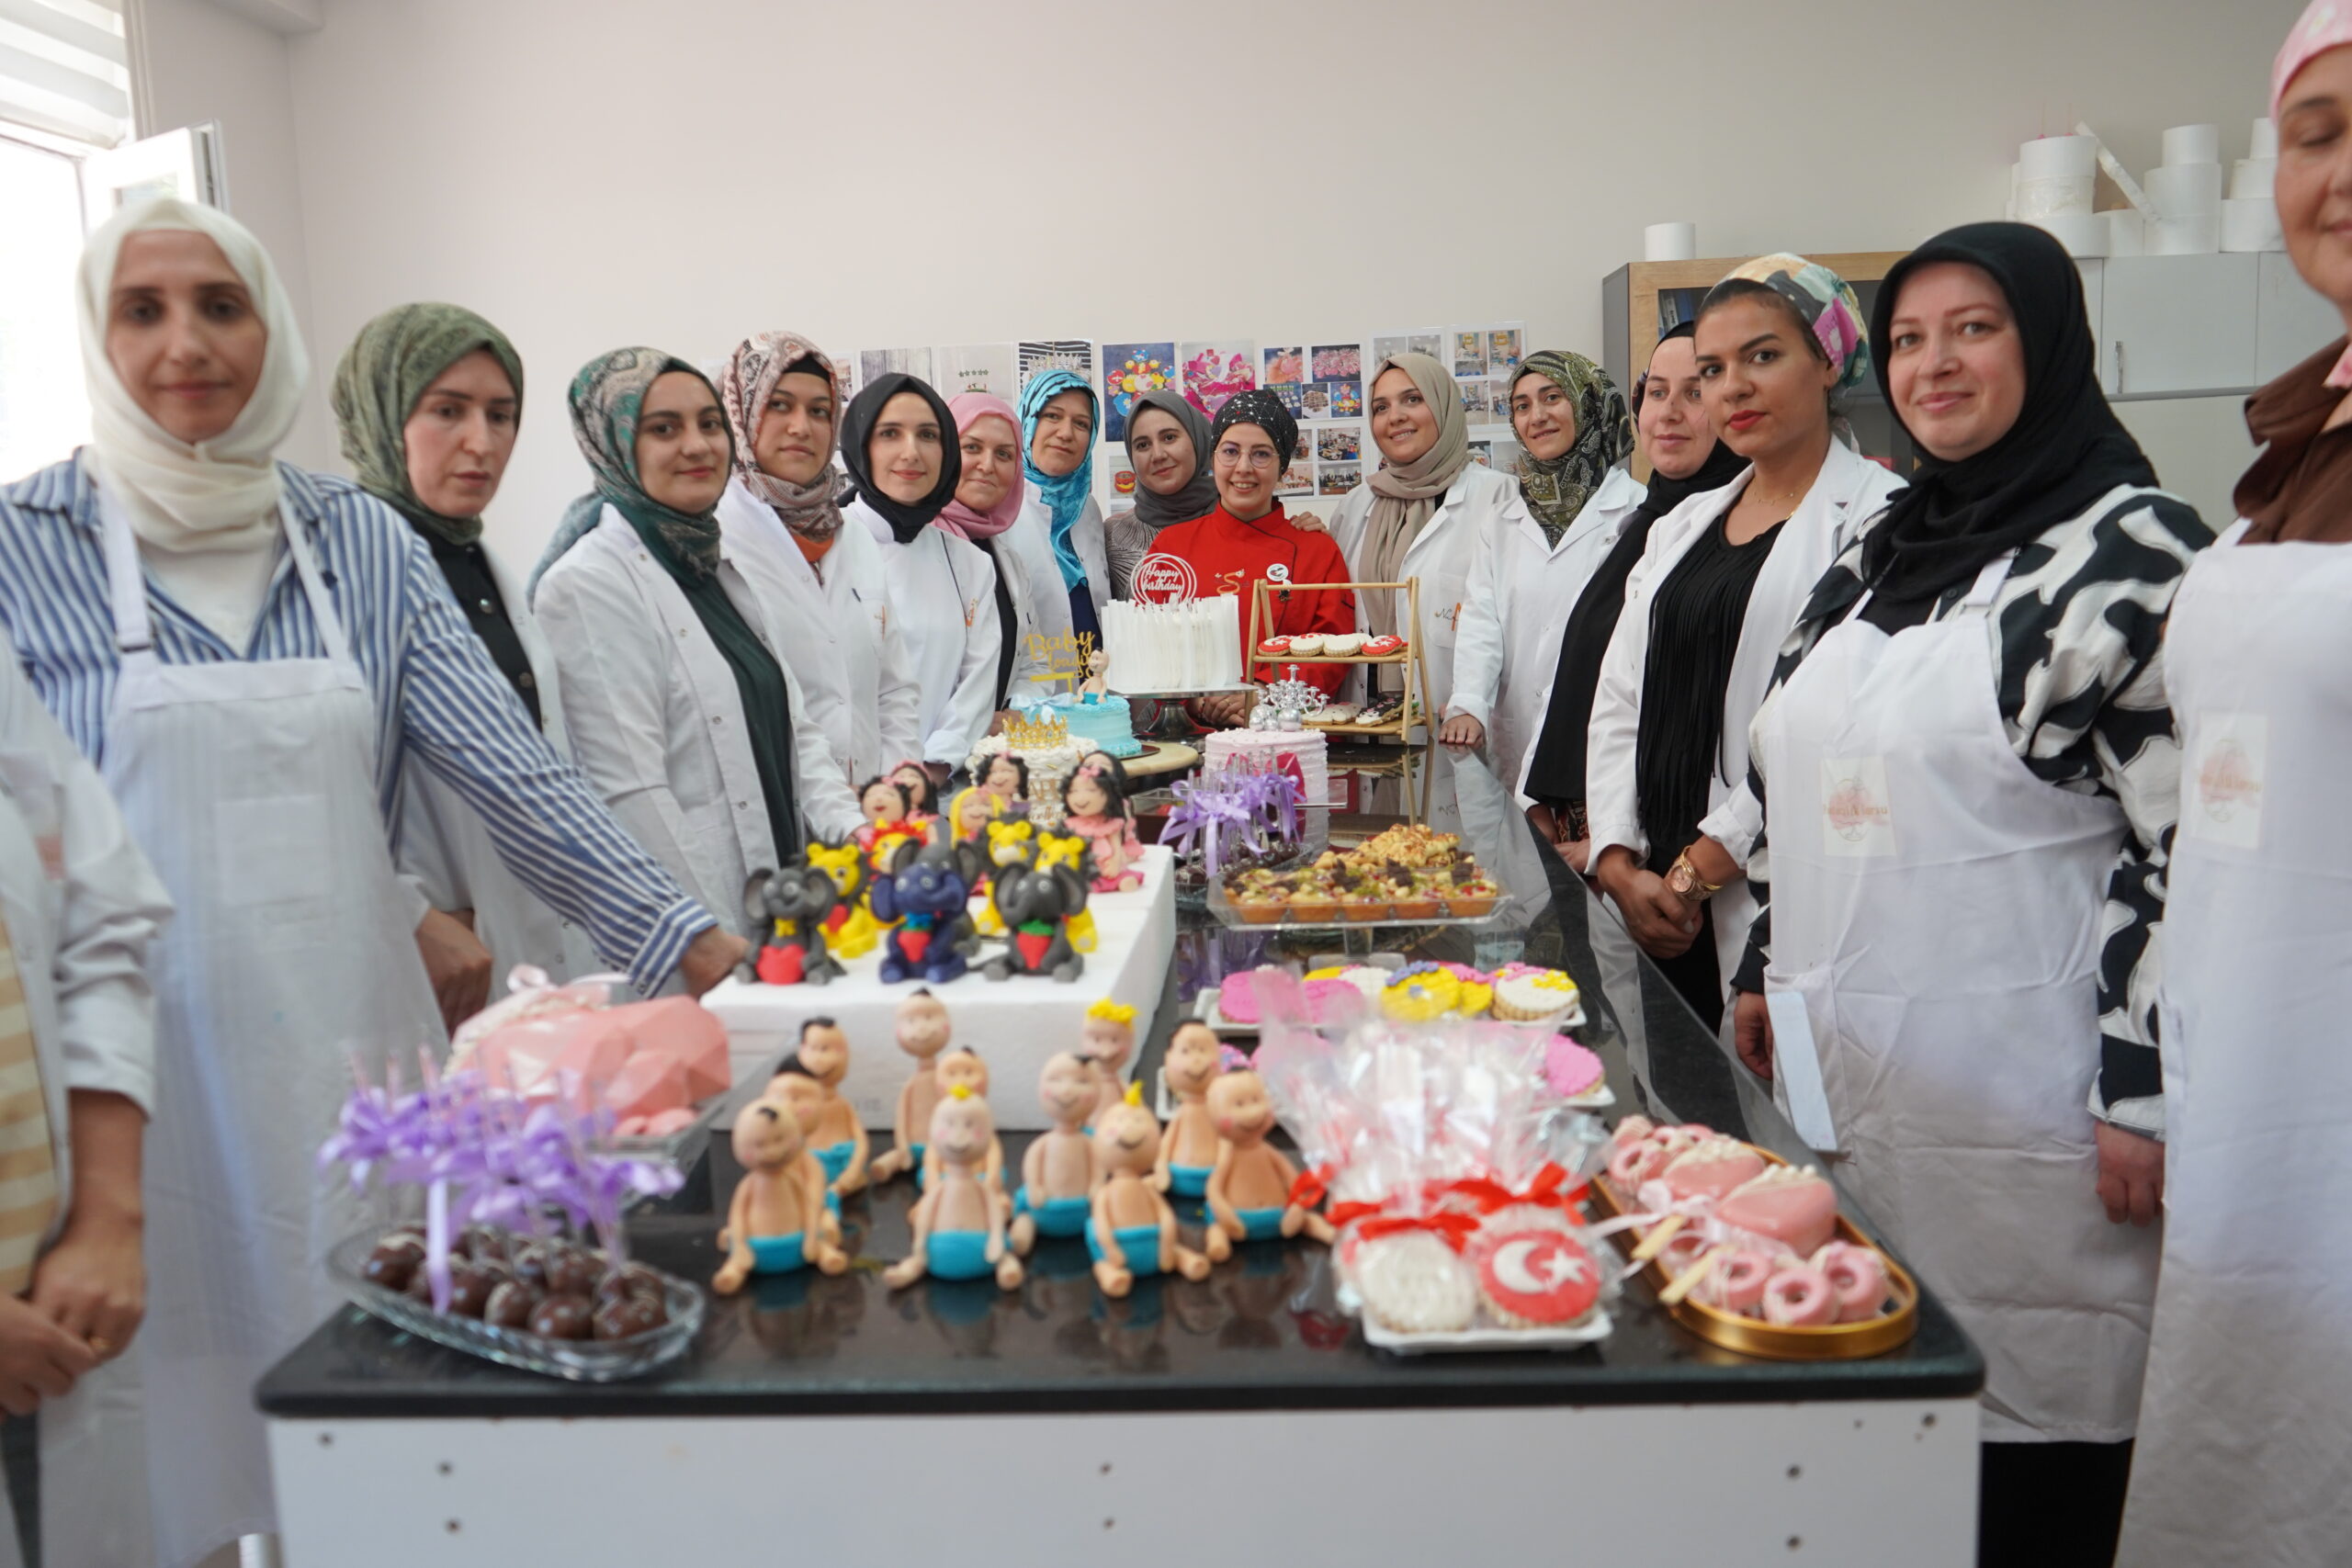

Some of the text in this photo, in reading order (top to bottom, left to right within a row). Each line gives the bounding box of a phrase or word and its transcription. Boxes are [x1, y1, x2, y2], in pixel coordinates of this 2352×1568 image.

[1145, 563, 1180, 582] Happy
[1143, 579, 1183, 598] birthday
[1022, 627, 1095, 660] Baby
